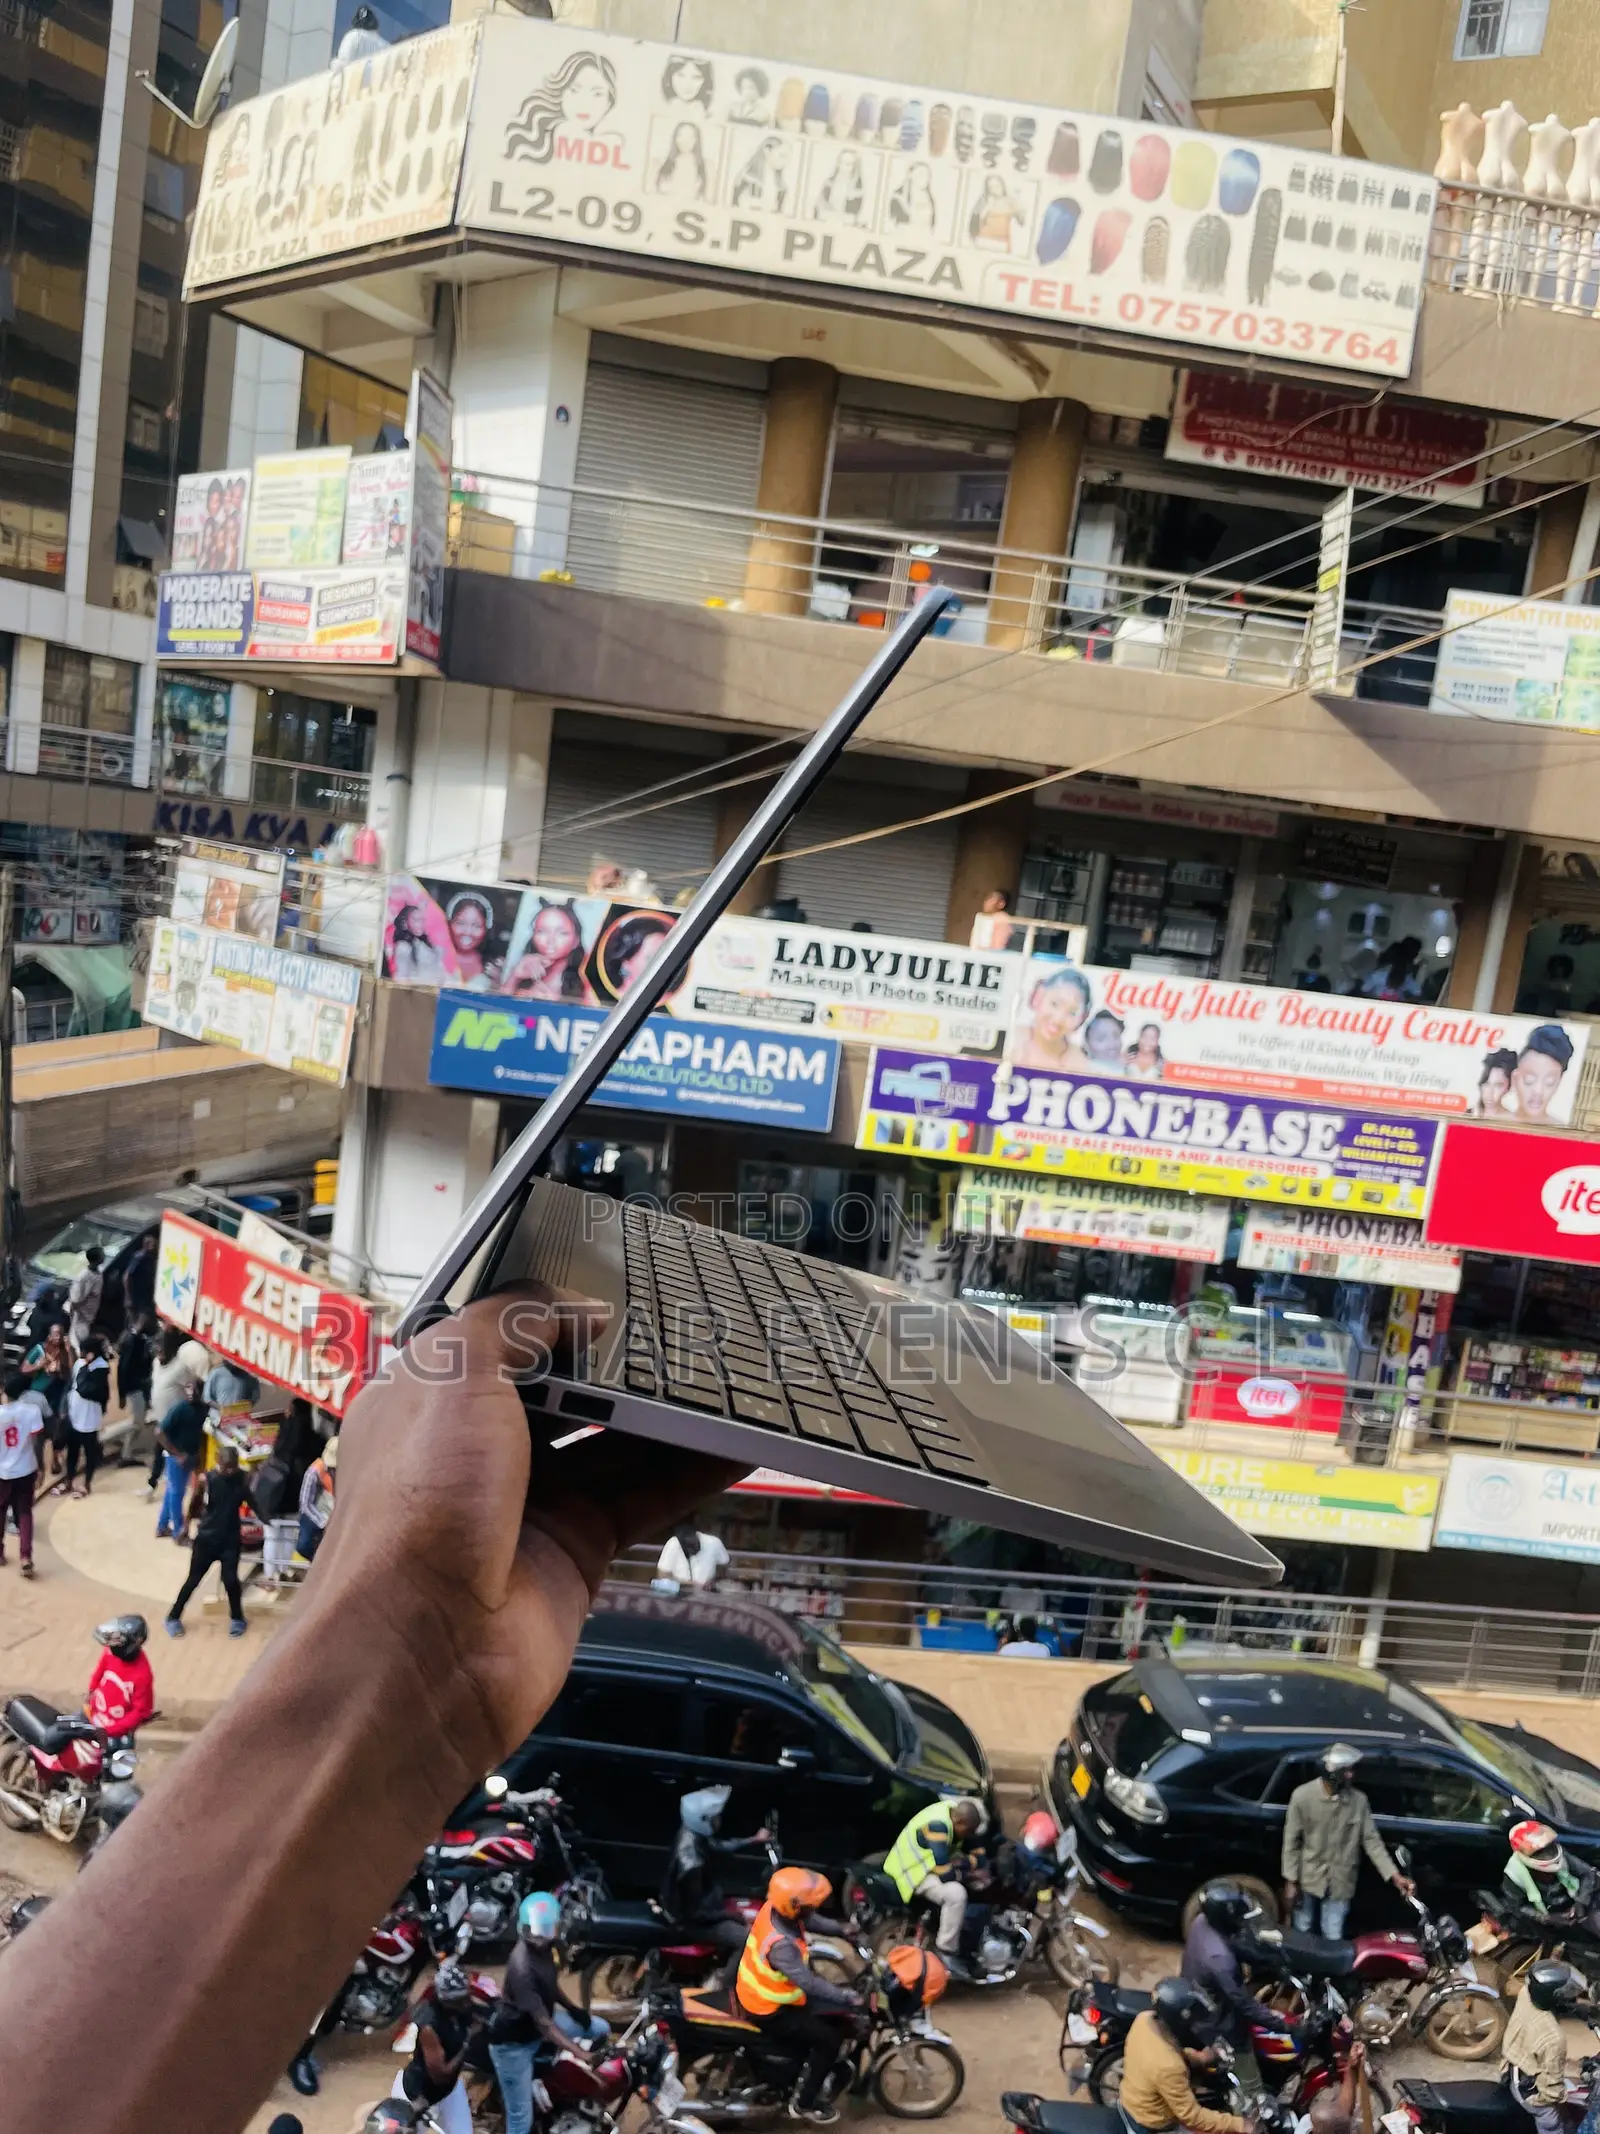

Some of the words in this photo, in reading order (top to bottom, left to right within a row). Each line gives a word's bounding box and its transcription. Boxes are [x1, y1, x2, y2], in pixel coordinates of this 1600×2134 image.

[553, 135, 631, 172] MDL
[259, 236, 309, 265] PLAZA
[488, 180, 655, 245] L2-09,
[672, 210, 762, 253] S.P
[781, 226, 965, 291] PLAZA
[997, 271, 1101, 318] TEL:
[1117, 292, 1401, 367] 0757033764
[163, 575, 252, 603] MODERATE
[170, 602, 245, 630] BRANDS
[154, 802, 236, 840] KISA
[244, 812, 310, 848] KYA
[775, 937, 1003, 991] LADYJULIE
[769, 968, 854, 997] Makeup
[868, 980, 927, 1005] Photo
[933, 989, 998, 1012] Studio
[1100, 968, 1191, 1024] Lady
[1180, 978, 1269, 1028] Julie
[1276, 993, 1396, 1048] Beauty
[1402, 1007, 1506, 1052] Centre
[535, 1014, 828, 1086] NEAPHARM
[986, 1068, 1347, 1164] PHONEBASE
[1111, 1139, 1175, 1160] PHONES
[1177, 1146, 1213, 1162] AND
[1213, 1150, 1319, 1178] ACCESSORIES
[1055, 1177, 1205, 1215] ENTERPRISES
[194, 1295, 357, 1411] PHARMACY
